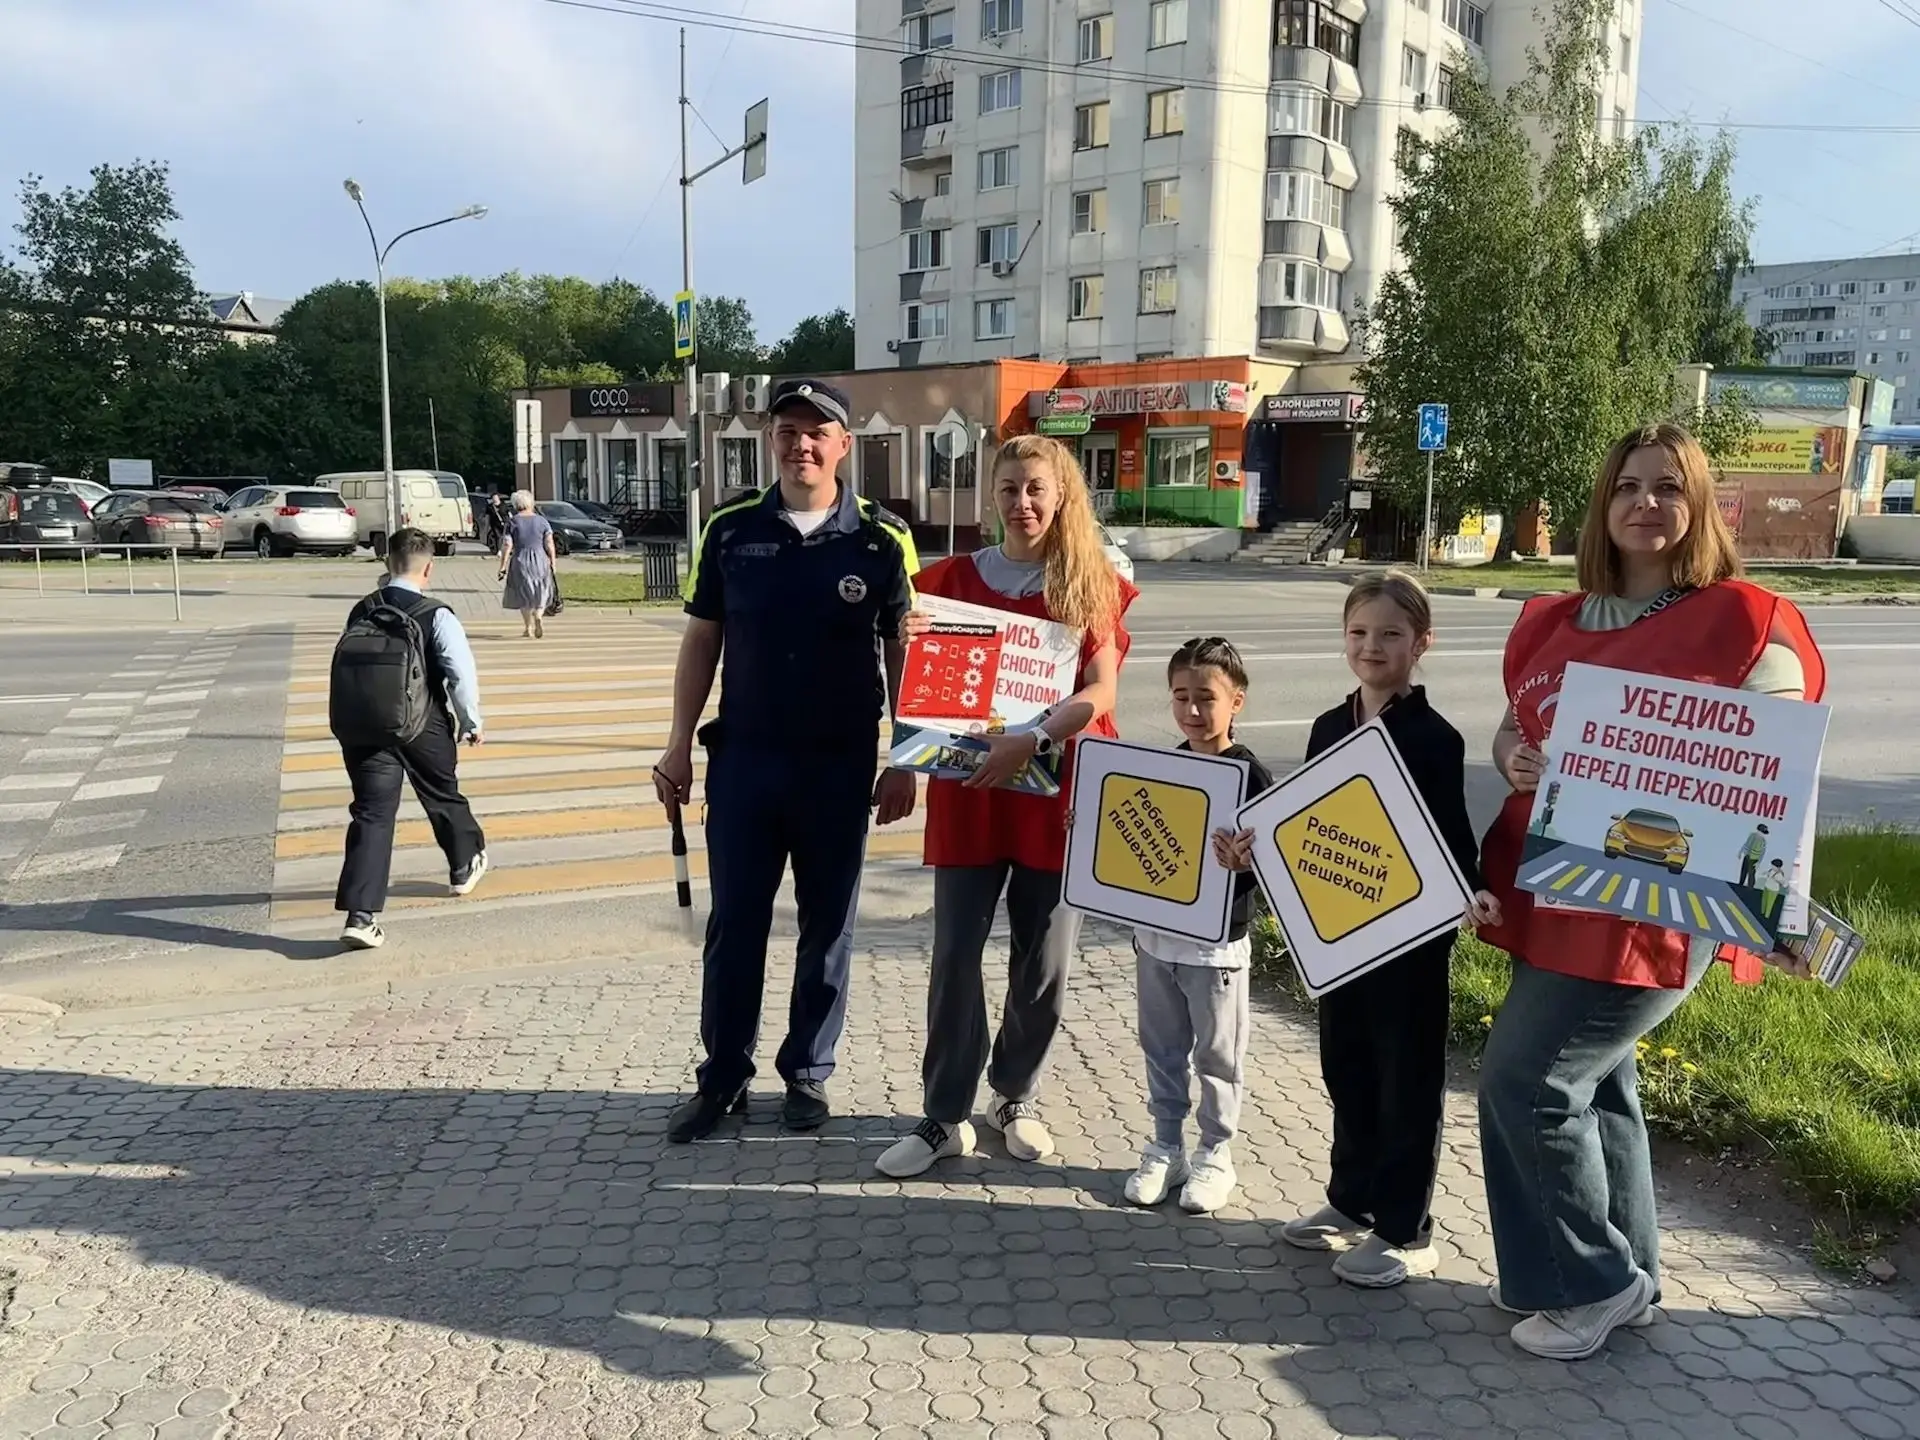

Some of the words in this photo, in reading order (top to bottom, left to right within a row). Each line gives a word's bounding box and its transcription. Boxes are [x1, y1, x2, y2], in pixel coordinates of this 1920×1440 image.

[1092, 383, 1190, 412] АПТЕКА
[1268, 399, 1301, 409] САЛОН
[1303, 398, 1341, 409] ЦВЕТОВ
[1291, 409, 1298, 417] И
[1298, 408, 1340, 418] ПОДАРКОВ
[930, 623, 994, 636] ПаркуйСмартфон
[1004, 622, 1041, 650] ИСЬ
[1000, 652, 1056, 680] СНОСТИ
[995, 677, 1061, 706] ЕХОДОМ!
[1619, 684, 1756, 737] УБЕДИСЬ
[1581, 720, 1598, 744] В
[1600, 724, 1781, 782] БЕЗОПАСНОСТИ
[1559, 751, 1632, 791] ПЕРЕД
[1634, 766, 1788, 821] ПЕРЕХОДОМ!
[1120, 799, 1180, 878] главный
[1133, 787, 1185, 858] Ребенок
[1306, 815, 1382, 859] Ребенок
[1107, 808, 1167, 887] пешеход!
[1301, 839, 1388, 883] главный
[1297, 857, 1384, 904] пешеход!
